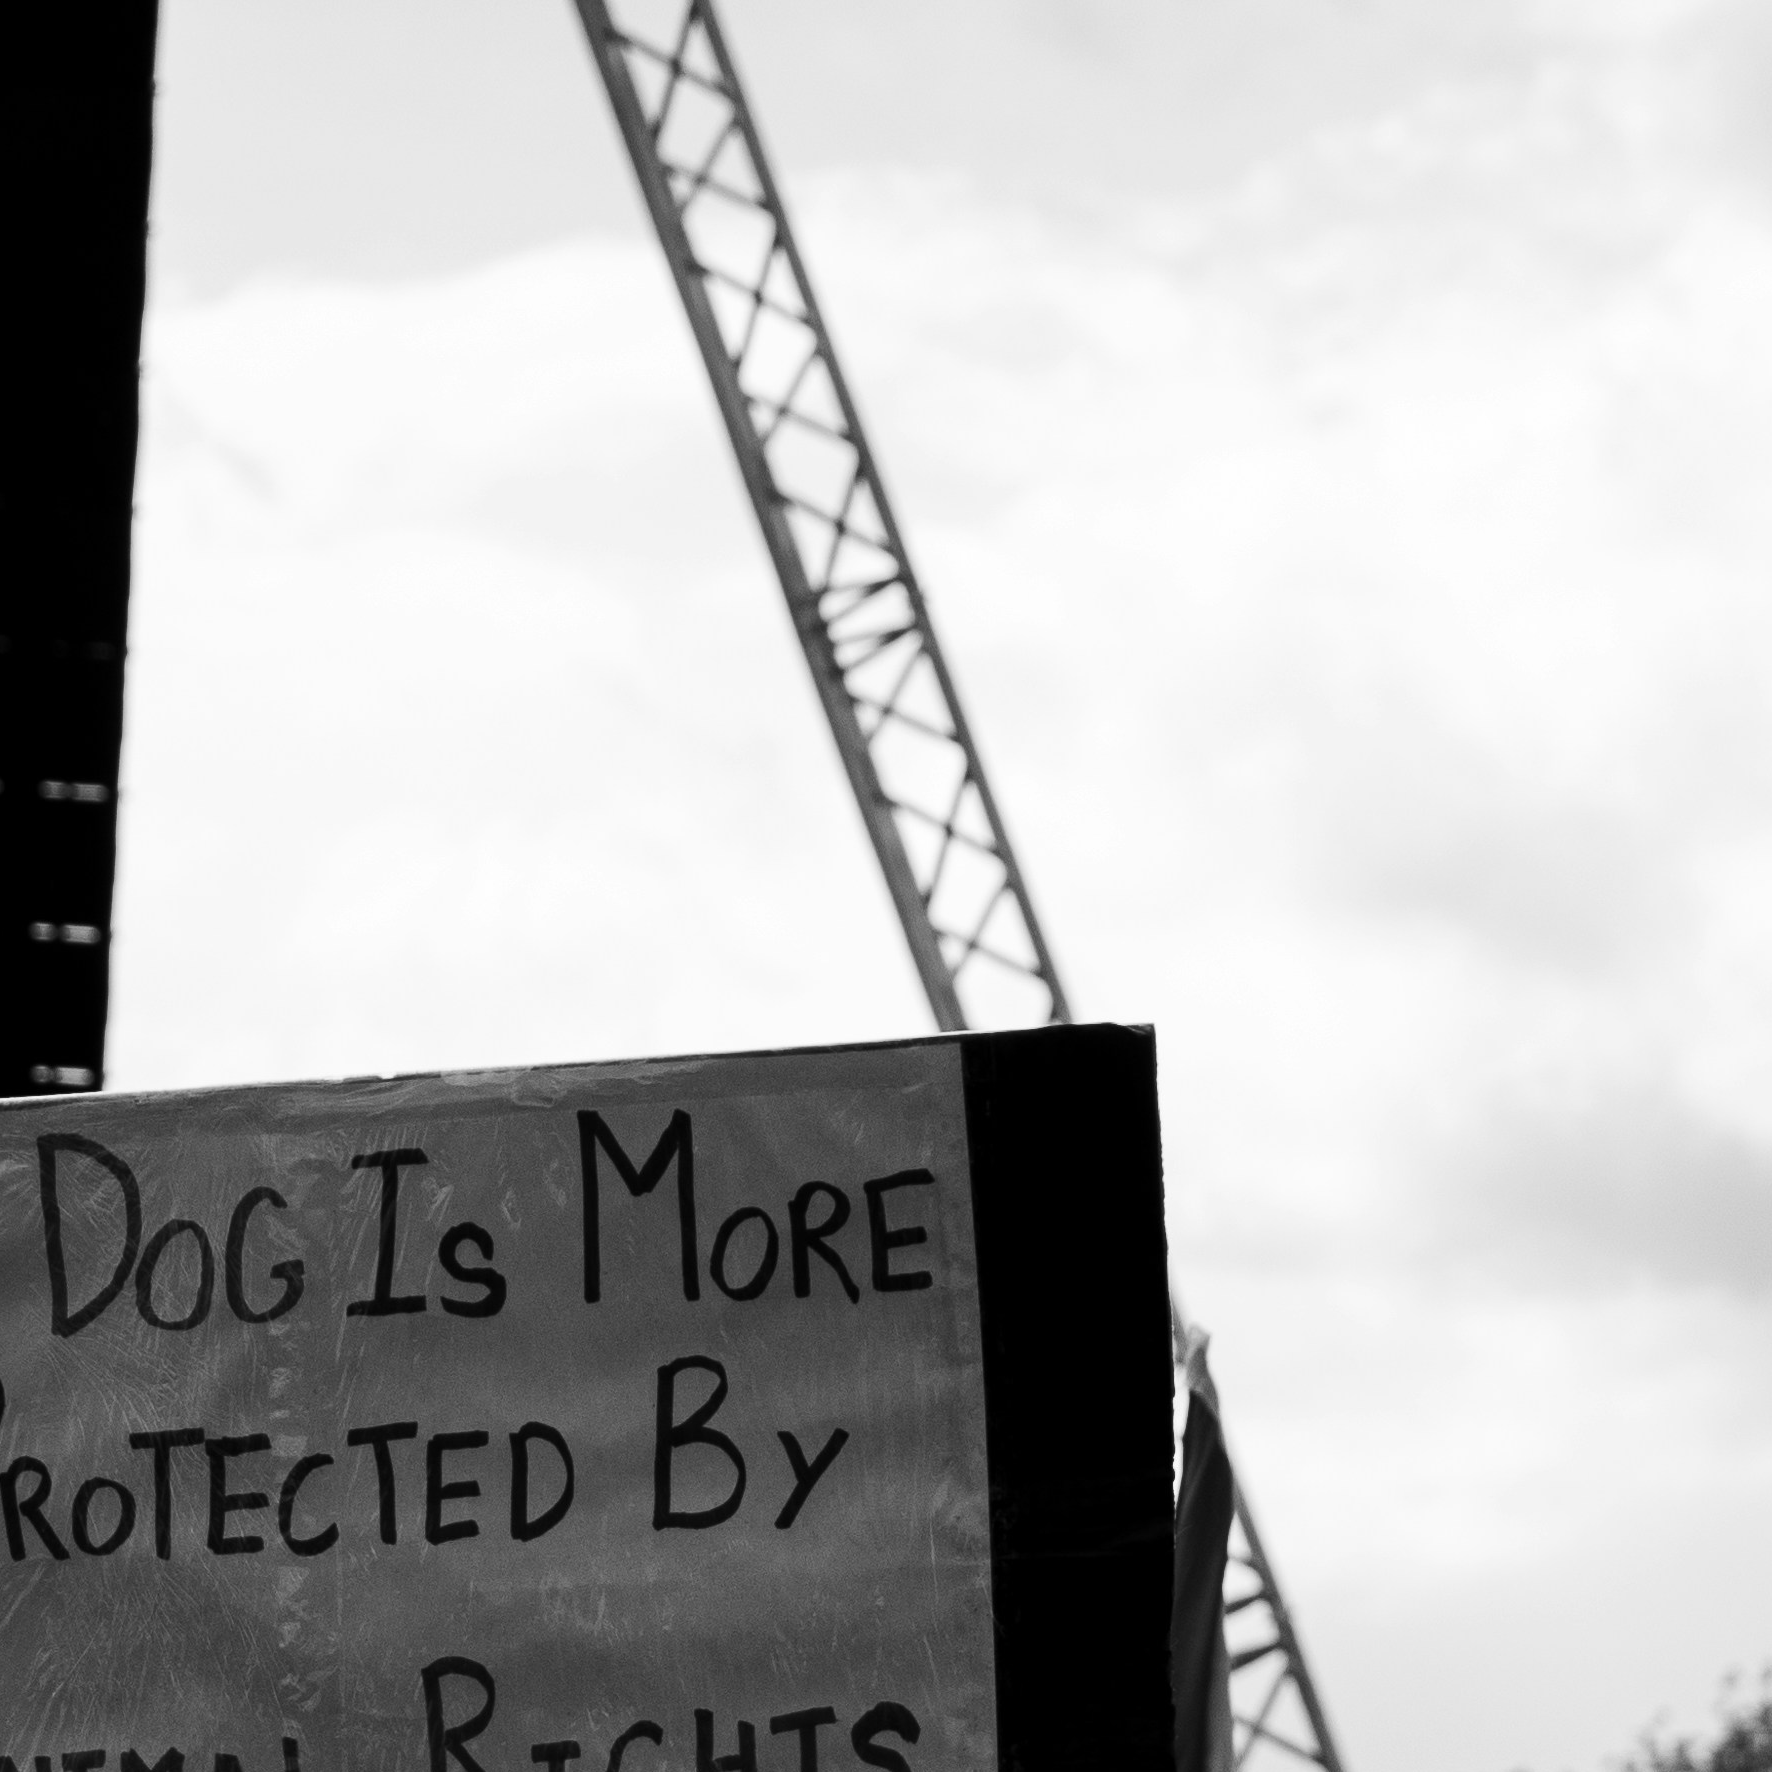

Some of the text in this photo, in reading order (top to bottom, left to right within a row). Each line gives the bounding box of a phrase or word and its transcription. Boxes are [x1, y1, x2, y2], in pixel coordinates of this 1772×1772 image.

[37, 1134, 303, 1337] DOG
[348, 1149, 506, 1319] IS
[577, 1110, 934, 1303] MORE
